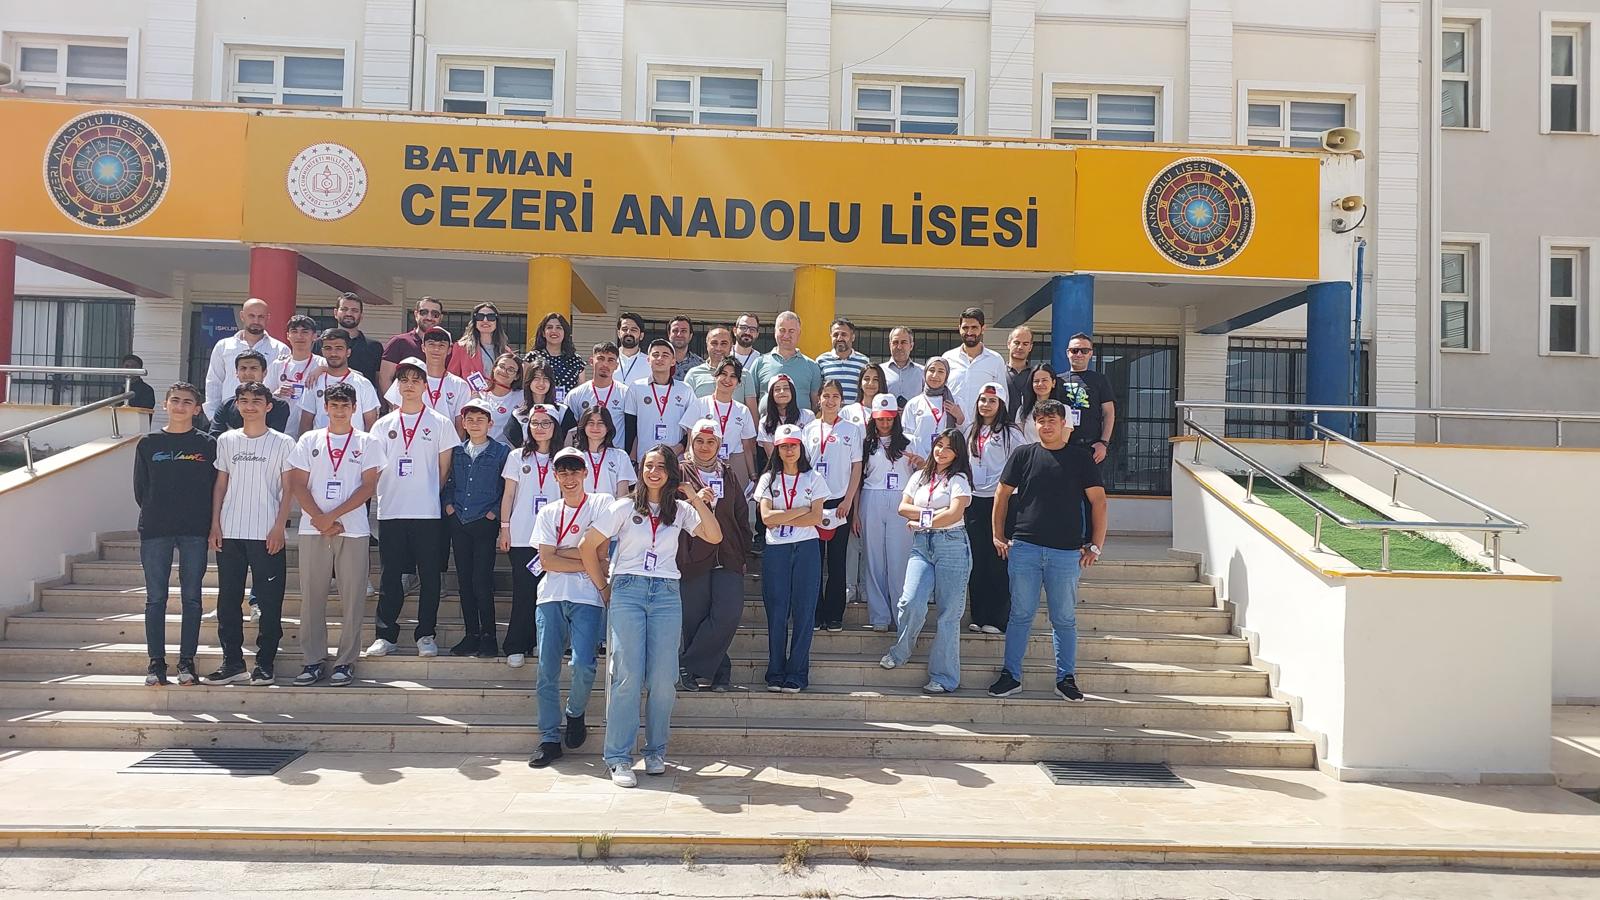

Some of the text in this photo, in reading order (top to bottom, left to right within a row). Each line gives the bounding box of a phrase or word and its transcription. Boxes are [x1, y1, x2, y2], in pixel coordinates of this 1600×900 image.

[53, 117, 103, 160] ANADOLU
[404, 145, 572, 177] BATMAN
[400, 179, 1038, 248] CEZERİ ANADOLU LİSESİ
[1148, 173, 1172, 229] ANADOLU
